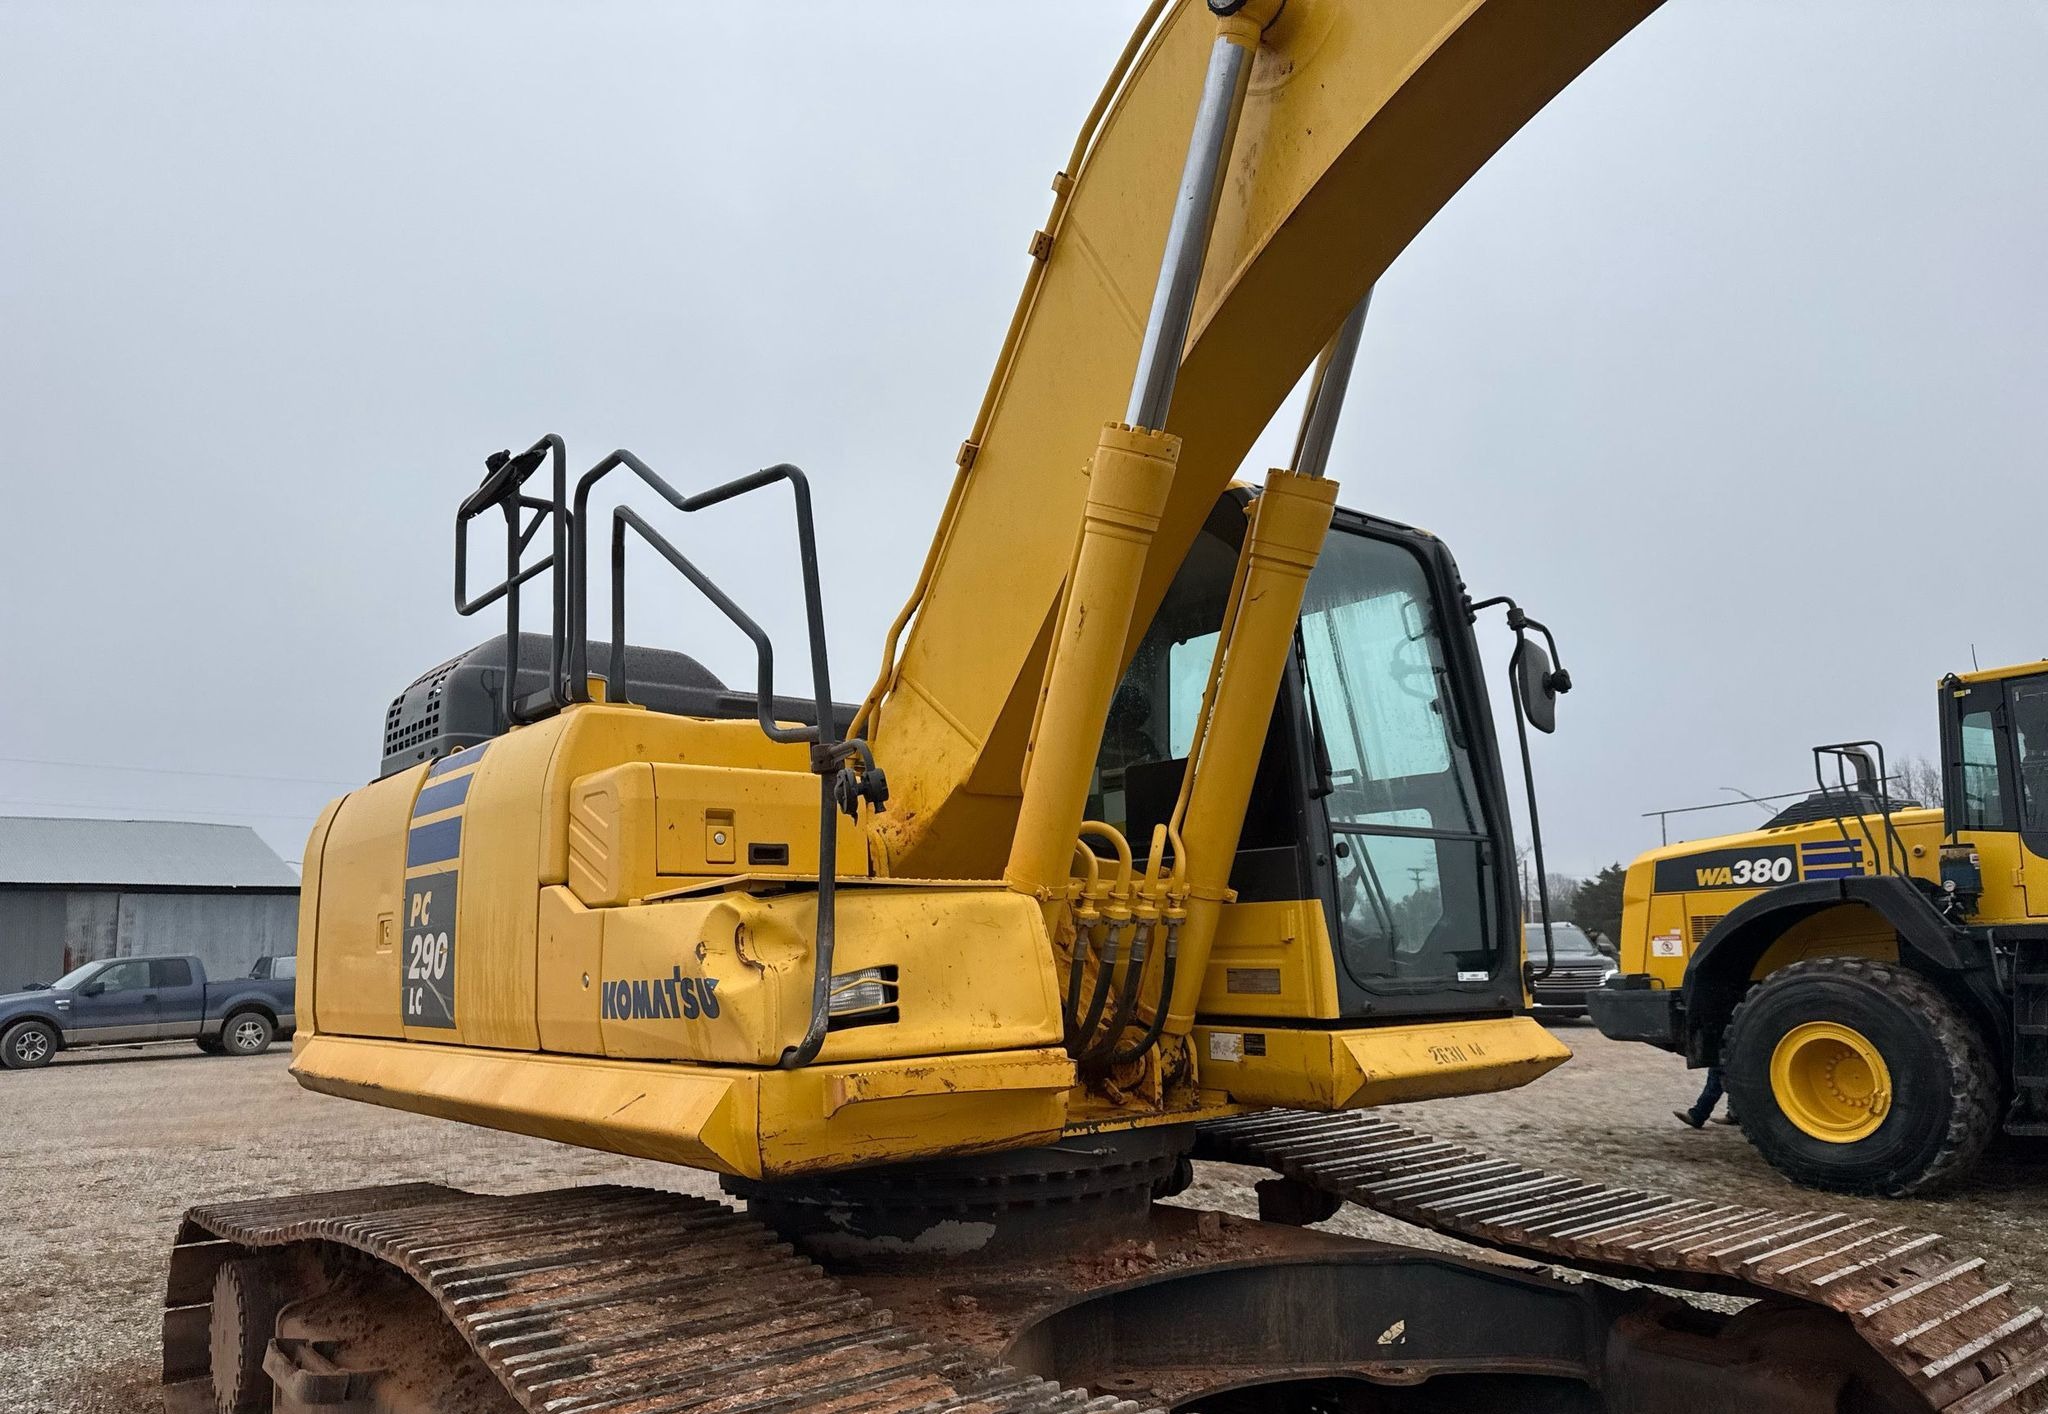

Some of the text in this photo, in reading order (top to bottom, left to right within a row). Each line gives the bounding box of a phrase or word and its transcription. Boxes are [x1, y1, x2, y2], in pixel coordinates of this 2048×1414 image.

[1695, 856, 1793, 887] WA380
[410, 890, 433, 928] PC
[408, 931, 449, 980] 290
[408, 986, 424, 1016] LC
[601, 965, 720, 1021] KOMATSU
